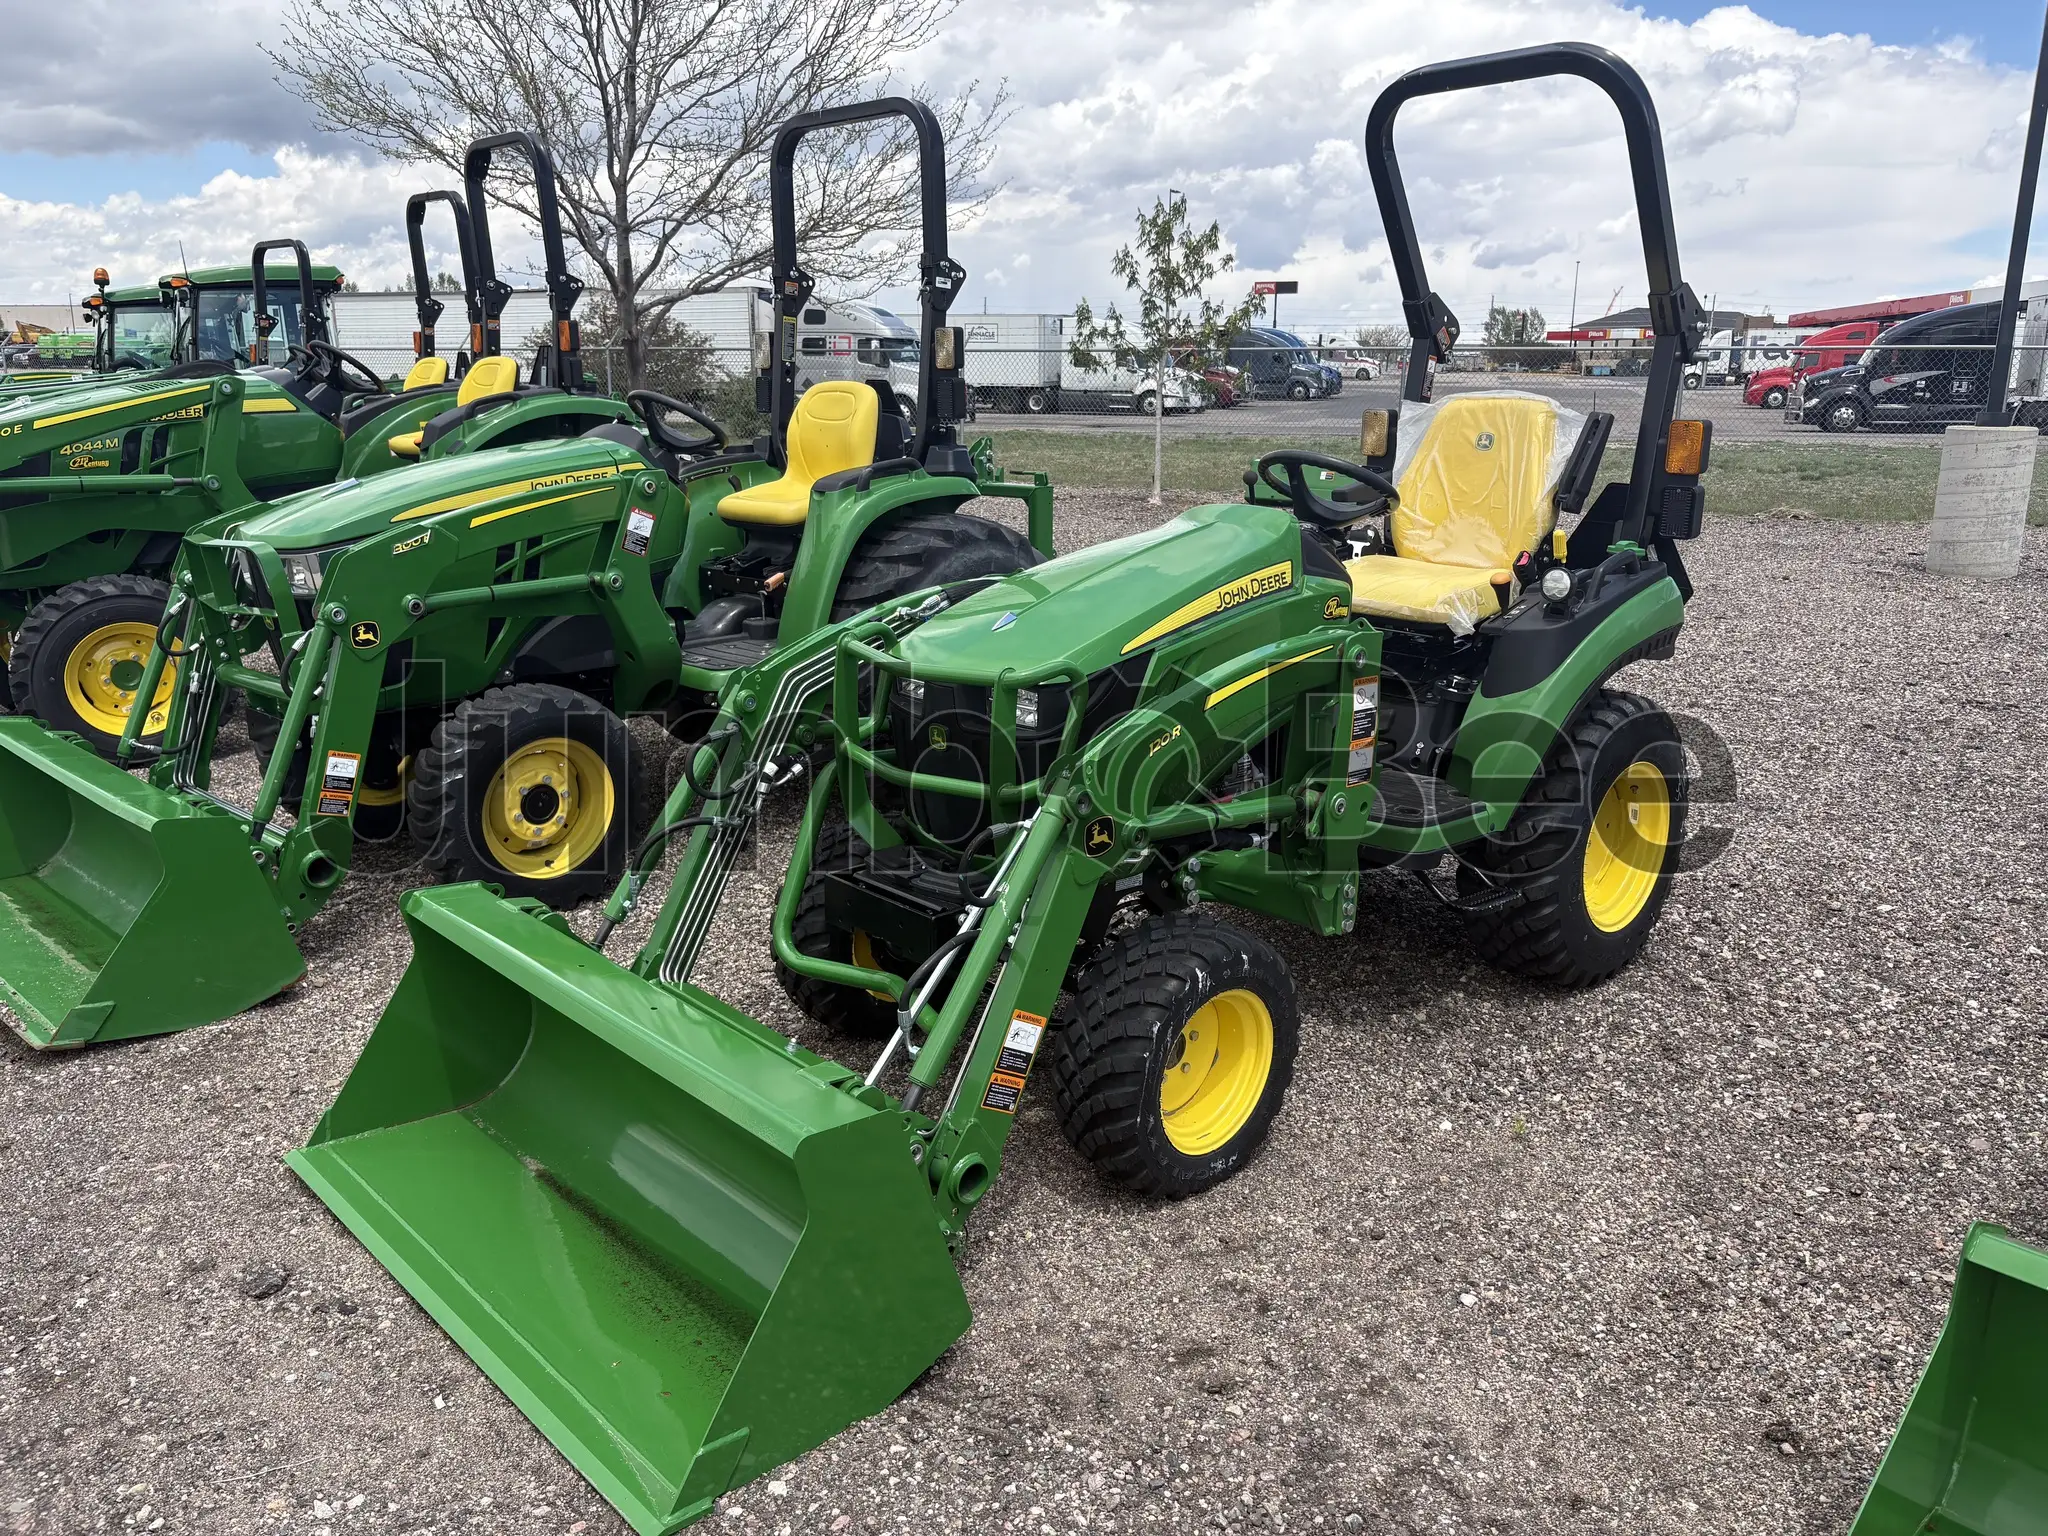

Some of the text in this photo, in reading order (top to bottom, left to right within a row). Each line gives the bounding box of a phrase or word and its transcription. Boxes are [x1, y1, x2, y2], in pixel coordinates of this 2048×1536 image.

[1216, 571, 1289, 611] JOHN DEERE
[1021, 1014, 1042, 1024] WARNING
[999, 1076, 1021, 1087] WARNING
